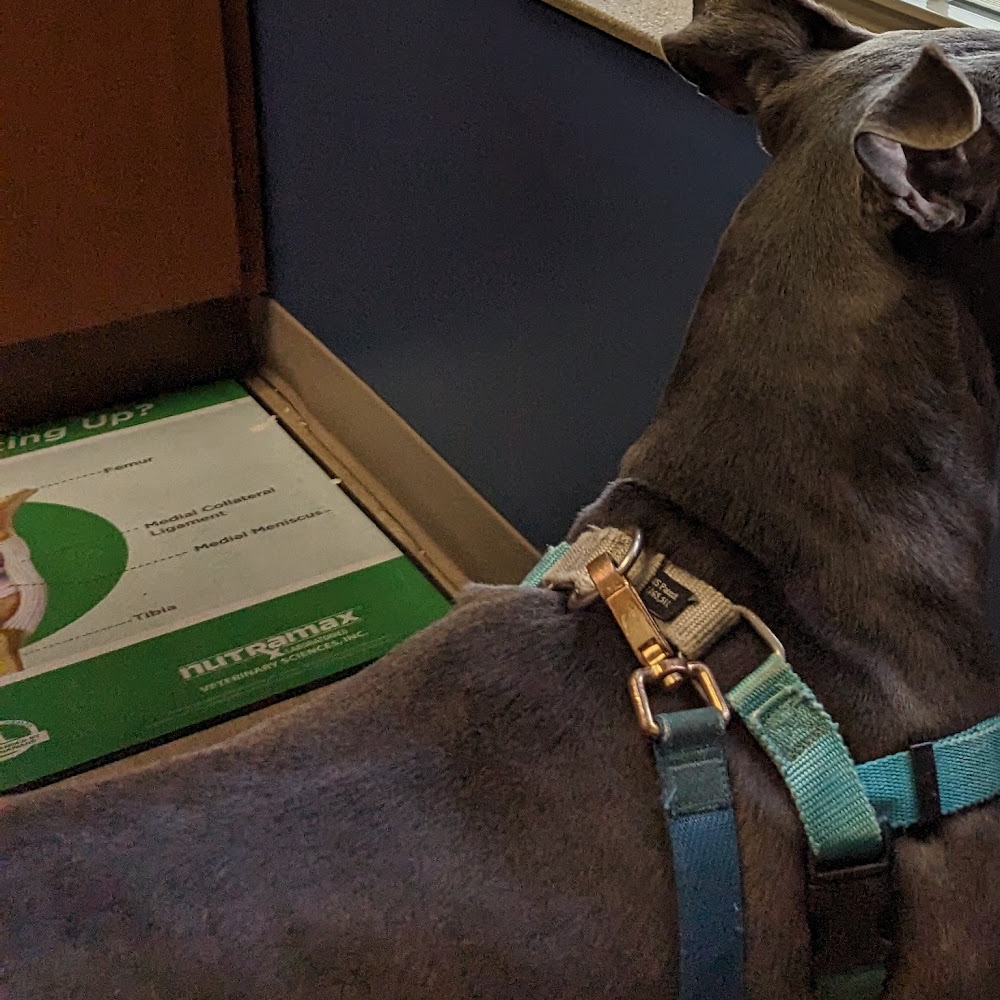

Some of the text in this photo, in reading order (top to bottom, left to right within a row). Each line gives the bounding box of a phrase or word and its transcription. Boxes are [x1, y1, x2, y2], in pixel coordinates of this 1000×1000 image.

[82, 403, 154, 430] Up?
[103, 457, 154, 474] Femur
[144, 487, 276, 529] Medial Collateral
[149, 510, 229, 537] Ligament
[193, 510, 323, 552] Medial Meniscus
[132, 605, 178, 621] Tibia
[199, 661, 279, 692] VETERINARY
